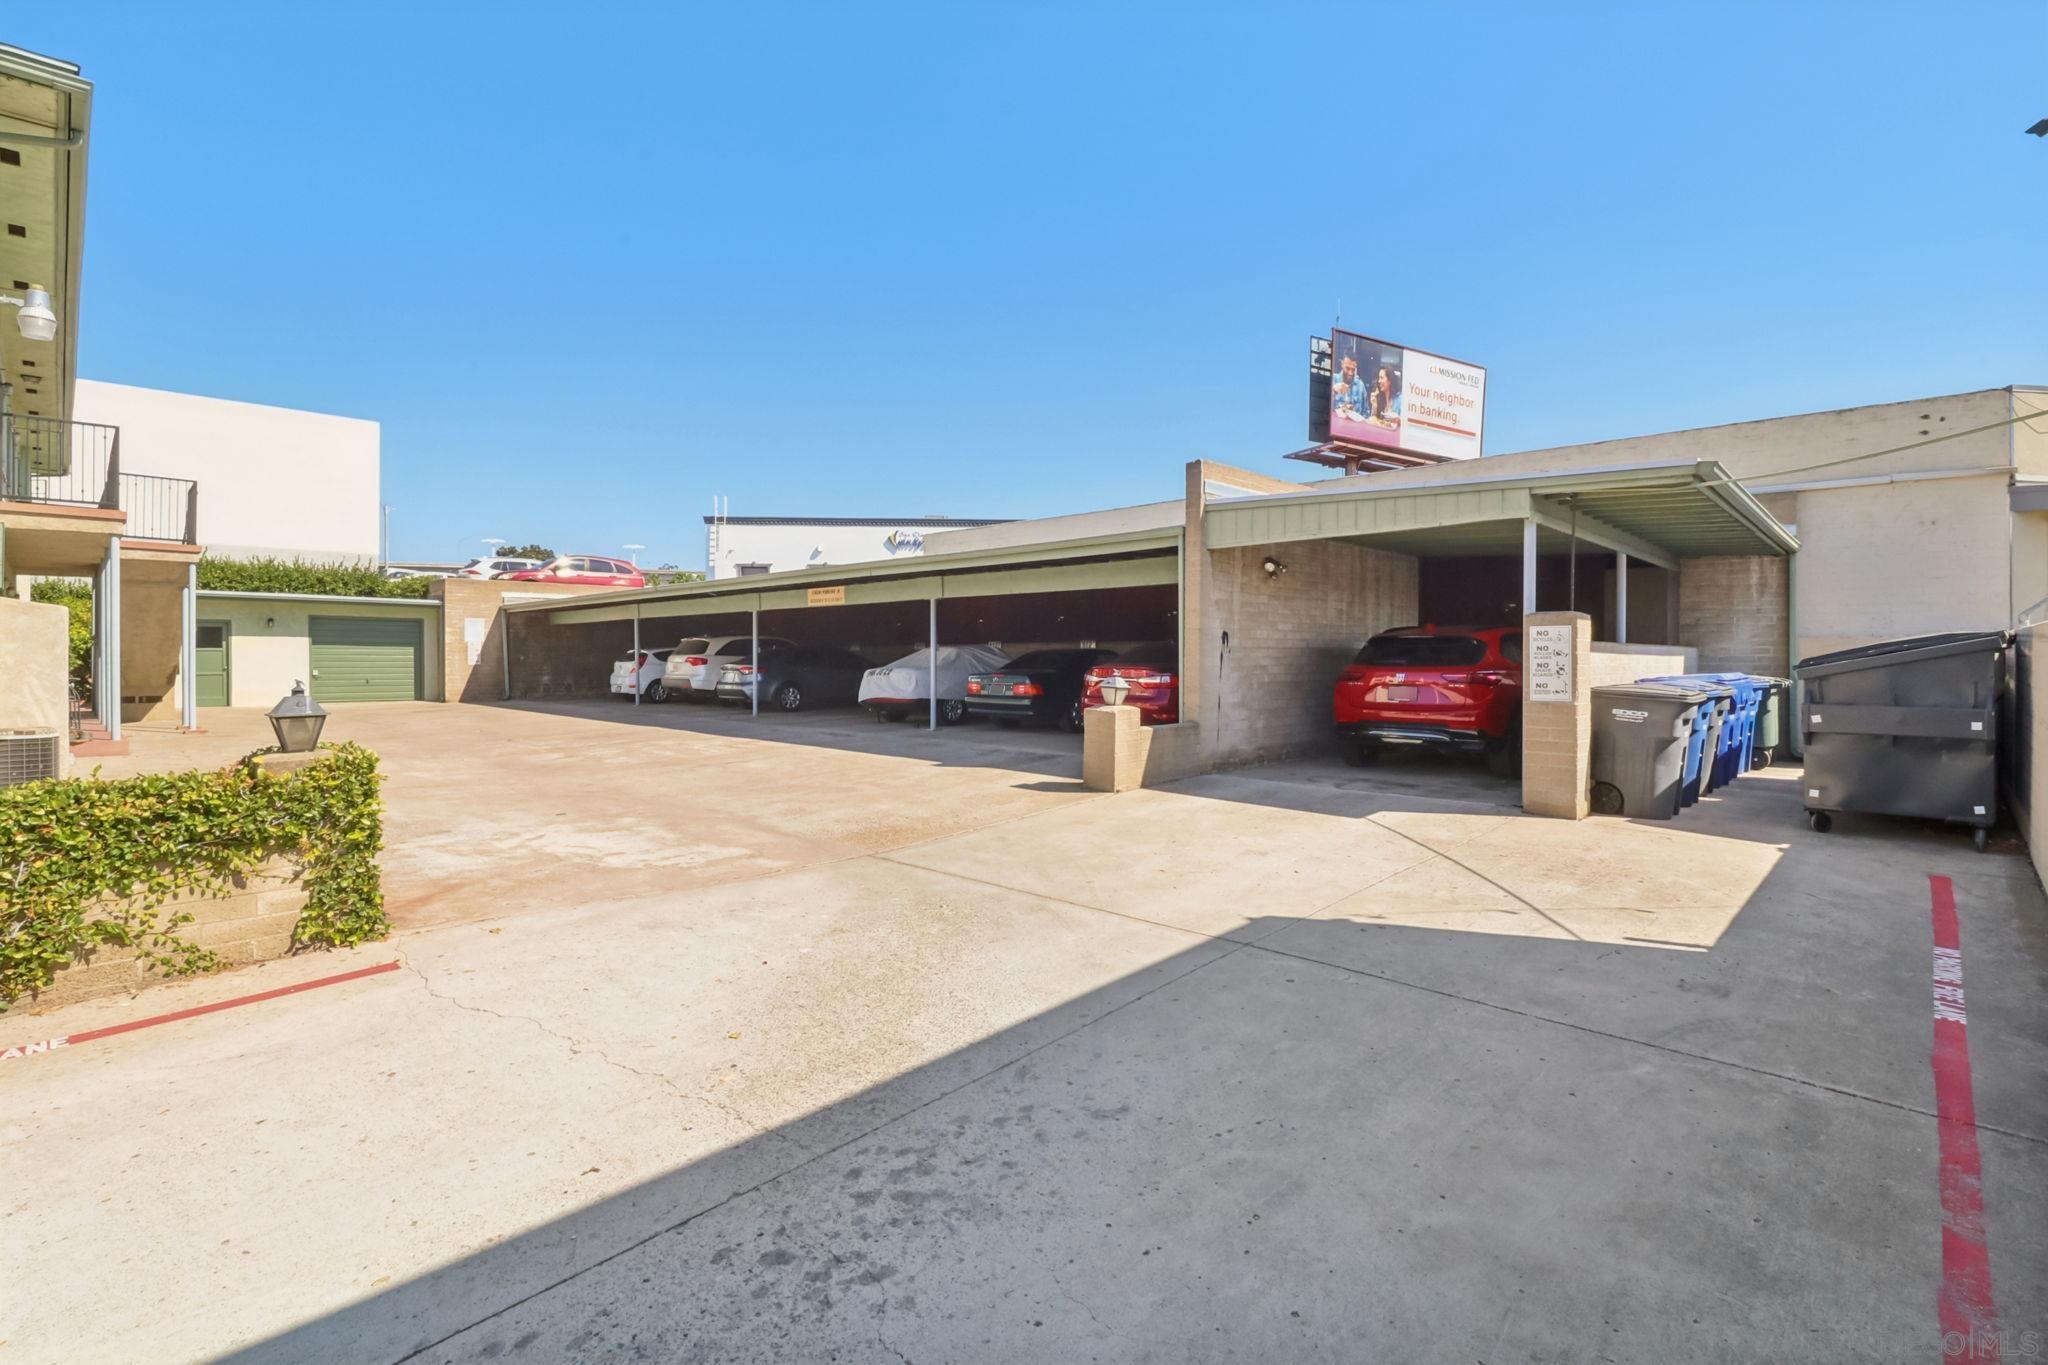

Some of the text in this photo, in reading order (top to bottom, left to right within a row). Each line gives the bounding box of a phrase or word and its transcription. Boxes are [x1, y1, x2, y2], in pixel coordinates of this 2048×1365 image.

[1438, 367, 1466, 381] MISSION
[1467, 374, 1480, 385] FED
[1409, 382, 1474, 409] Your neighbor
[1408, 401, 1460, 424] in banking.
[0, 1035, 69, 1060] ANE
